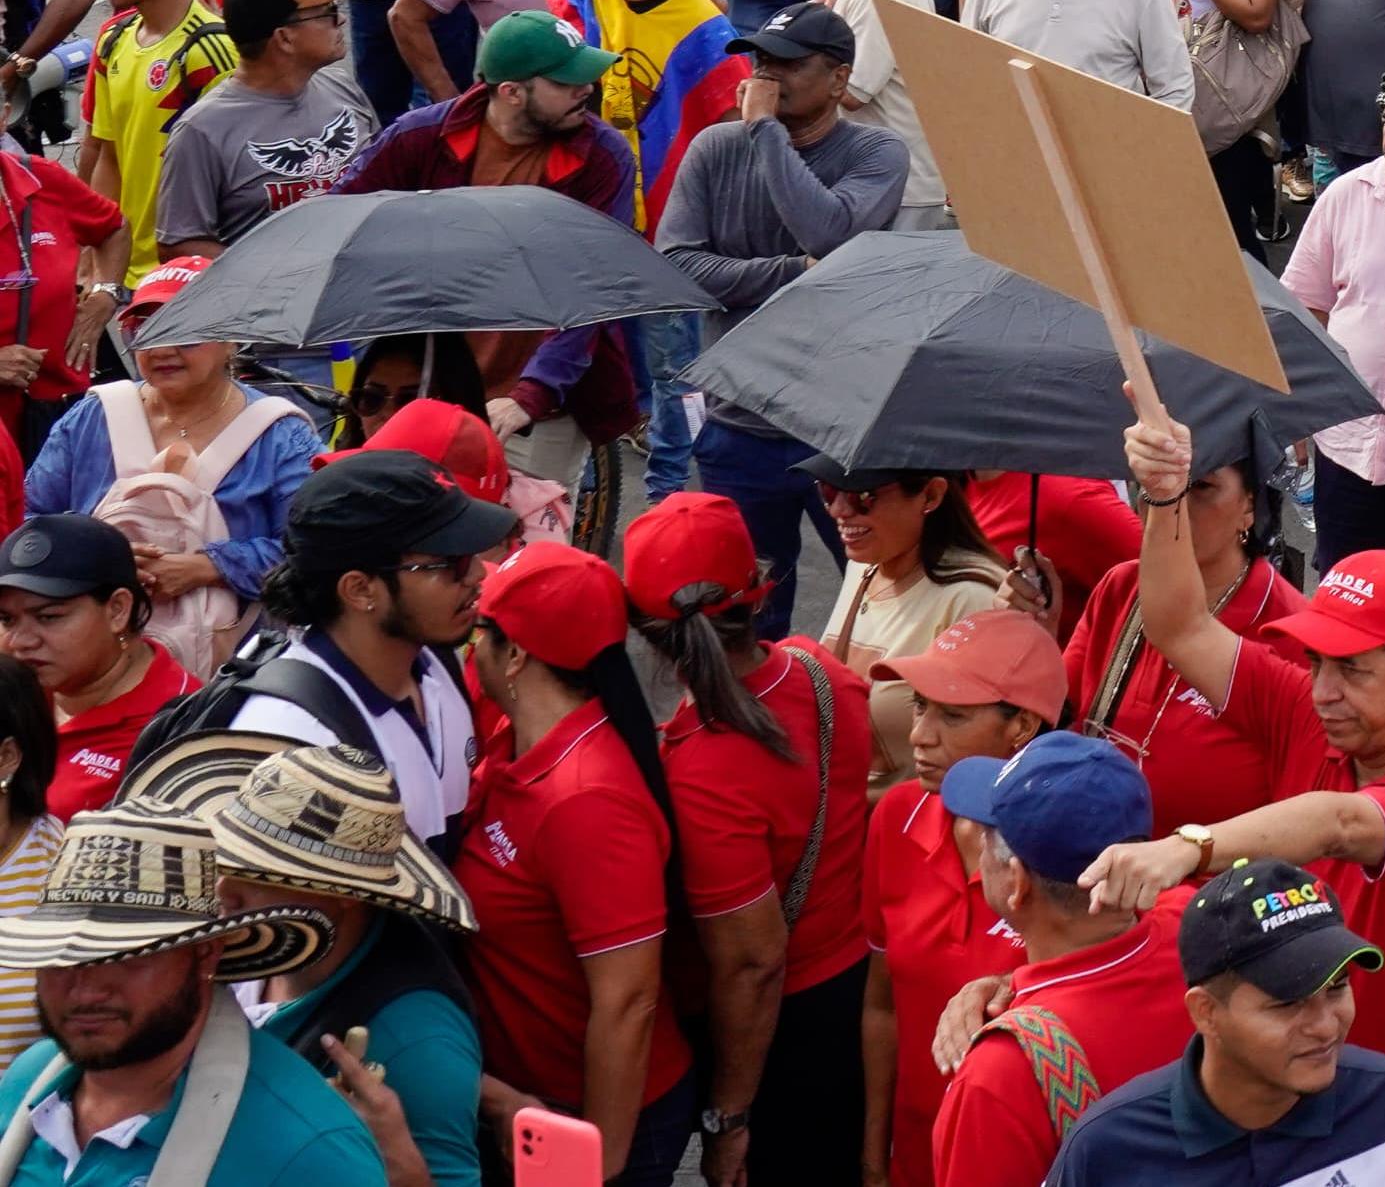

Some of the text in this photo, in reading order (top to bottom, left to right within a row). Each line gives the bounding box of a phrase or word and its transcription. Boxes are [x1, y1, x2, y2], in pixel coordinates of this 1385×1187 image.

[47, 889, 165, 908] HECTOR Y SAID
[1252, 884, 1319, 921] PETRO
[1260, 901, 1334, 934] PRESIDENTE
